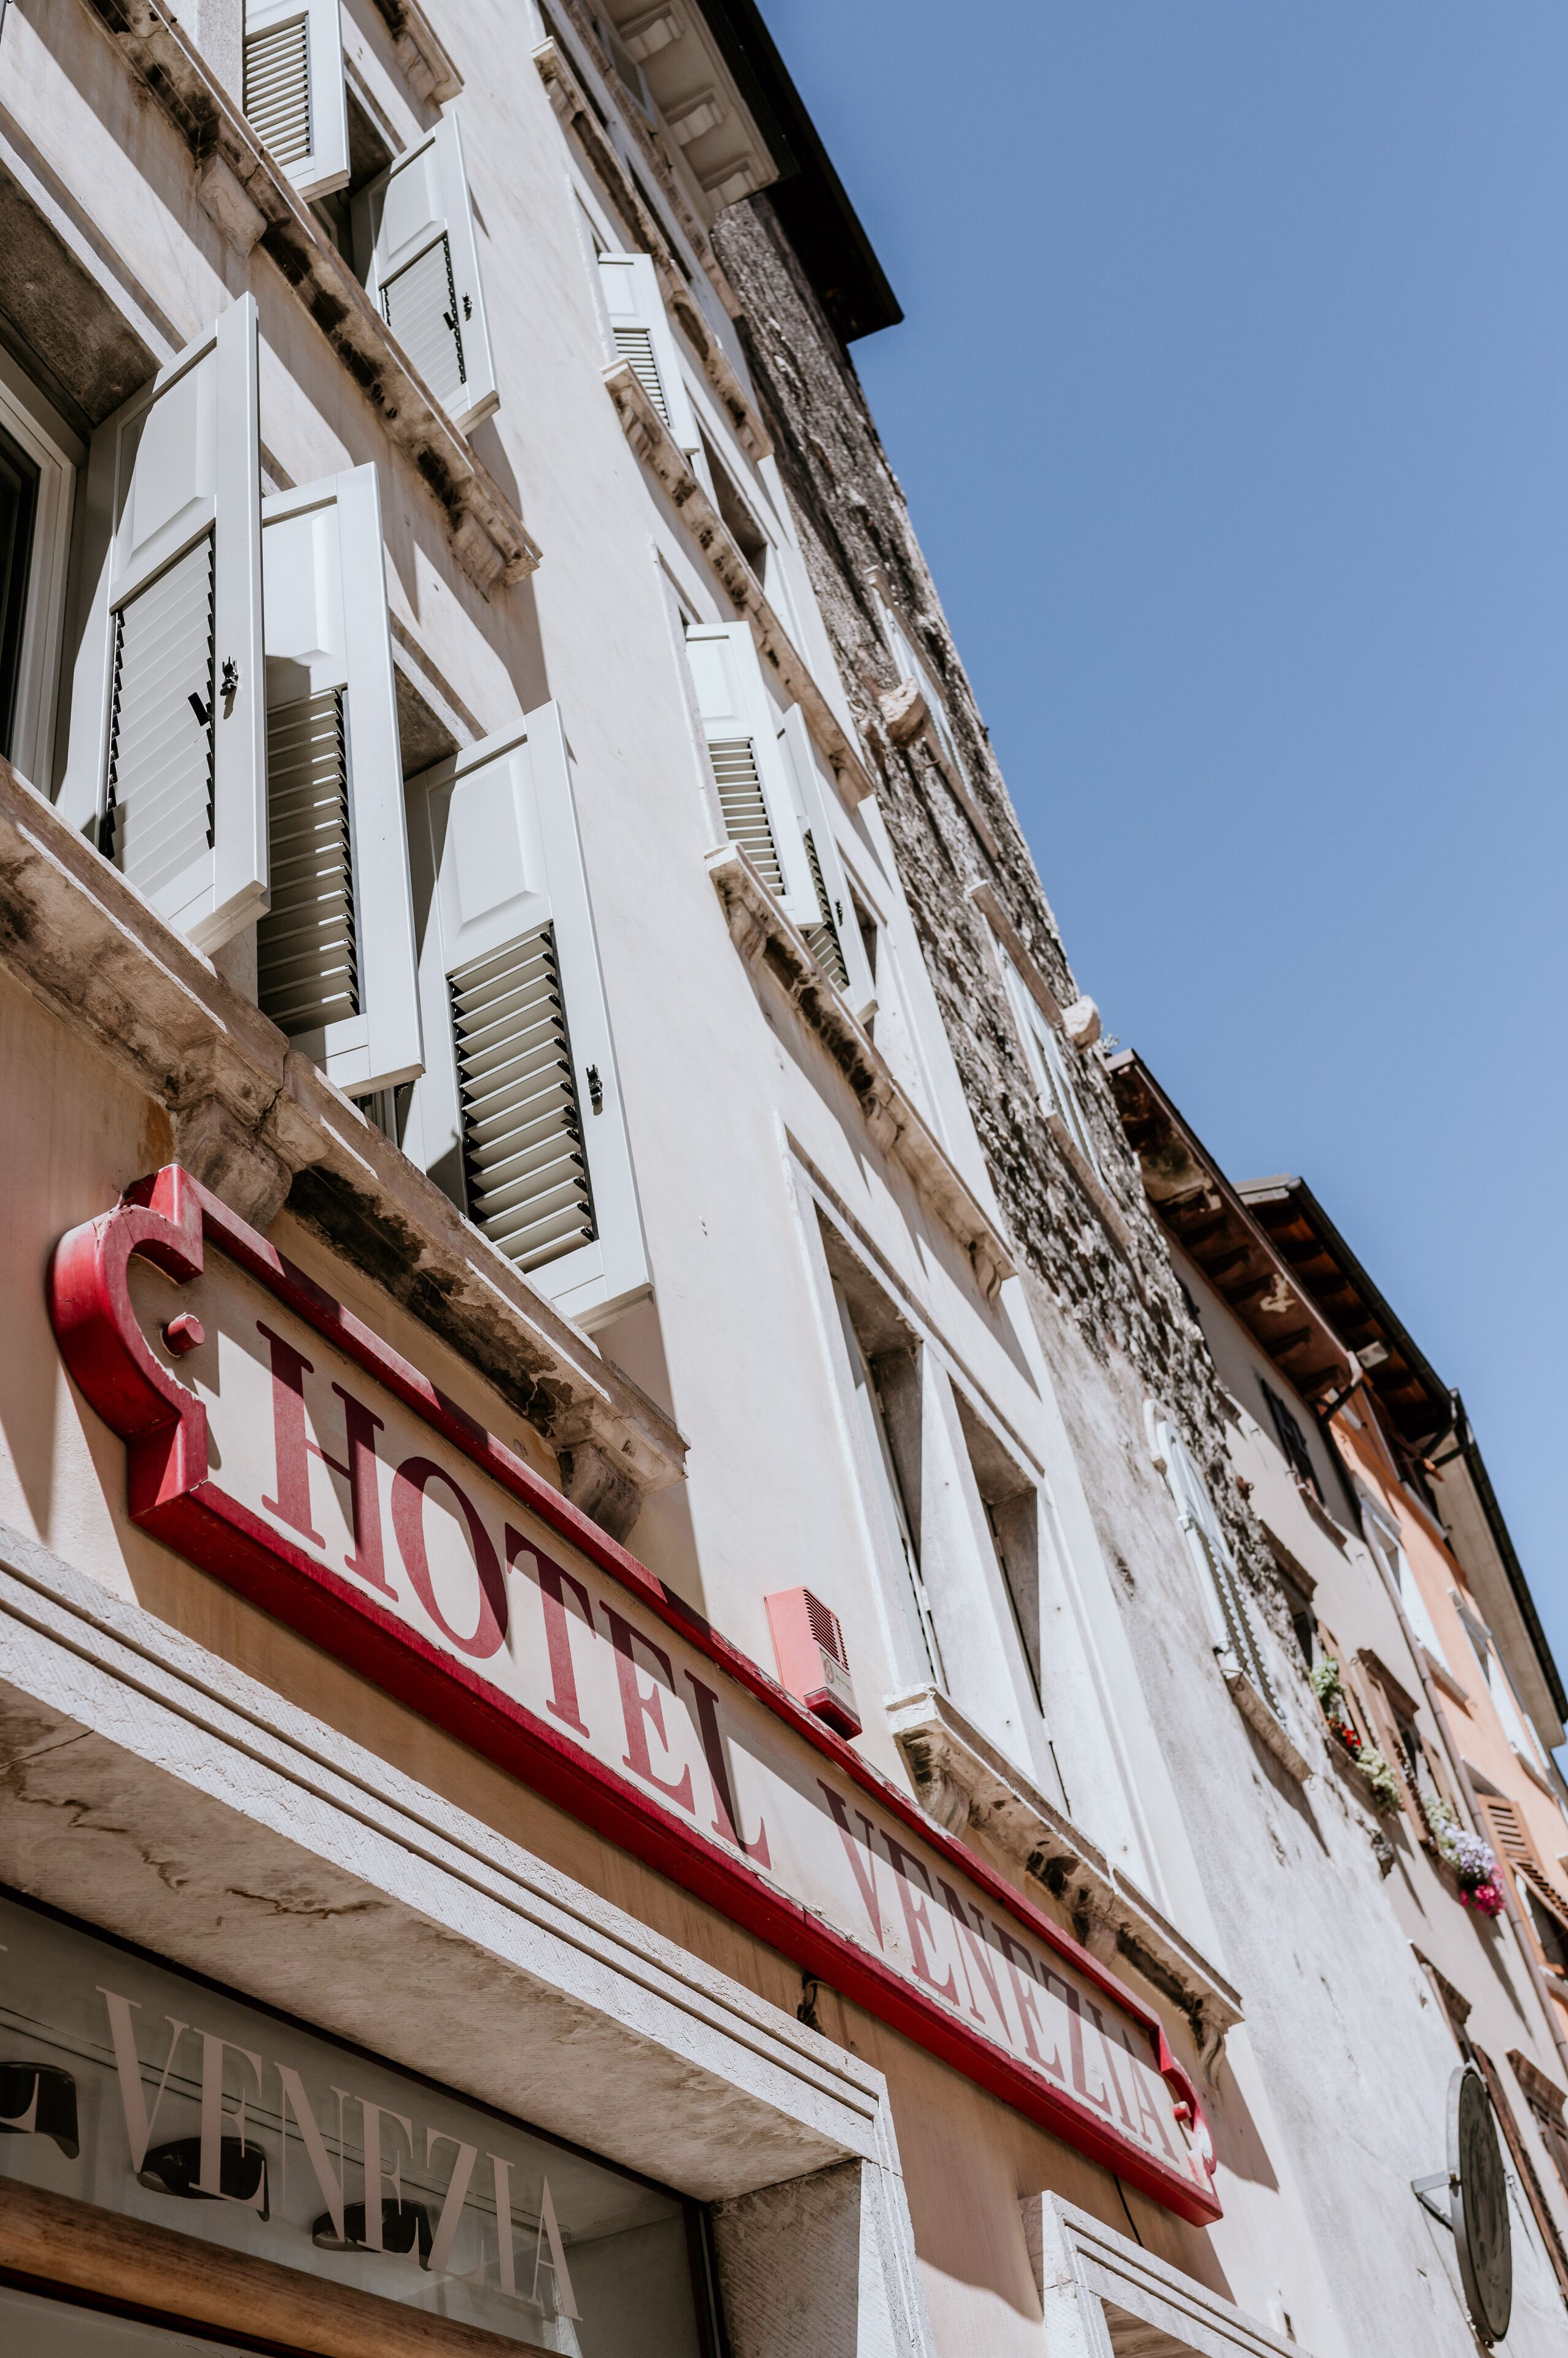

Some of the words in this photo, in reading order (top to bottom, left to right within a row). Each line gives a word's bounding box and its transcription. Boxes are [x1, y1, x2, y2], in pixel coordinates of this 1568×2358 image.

[256, 1320, 772, 1870] HOTEL
[817, 1777, 1180, 2164] VENEZIA
[95, 1985, 584, 2322] VENEZIA
